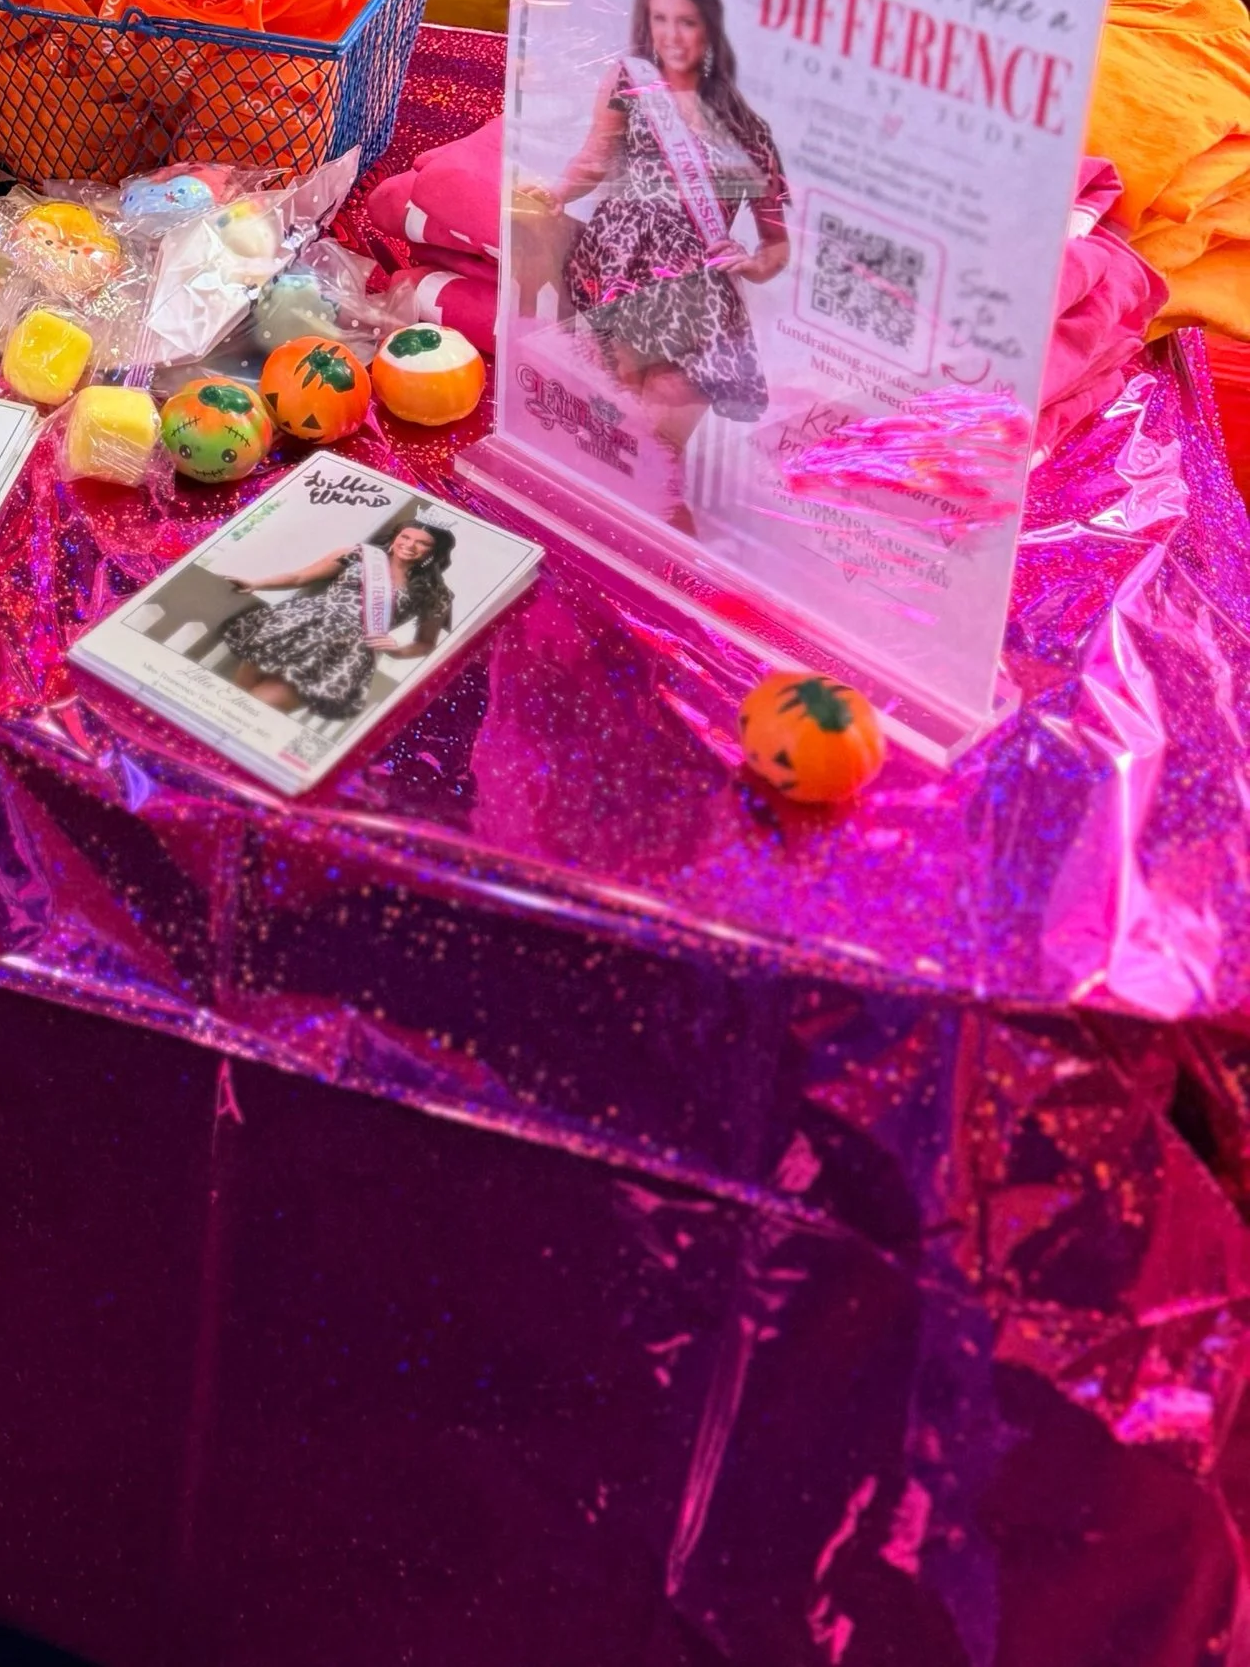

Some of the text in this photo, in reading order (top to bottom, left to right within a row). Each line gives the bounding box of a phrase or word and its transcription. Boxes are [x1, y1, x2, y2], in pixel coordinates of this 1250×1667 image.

[1047, 13, 1078, 35] a
[783, 47, 844, 82] FOR
[935, 108, 1028, 154] JUDE
[672, 139, 722, 239] TENNESSEE
